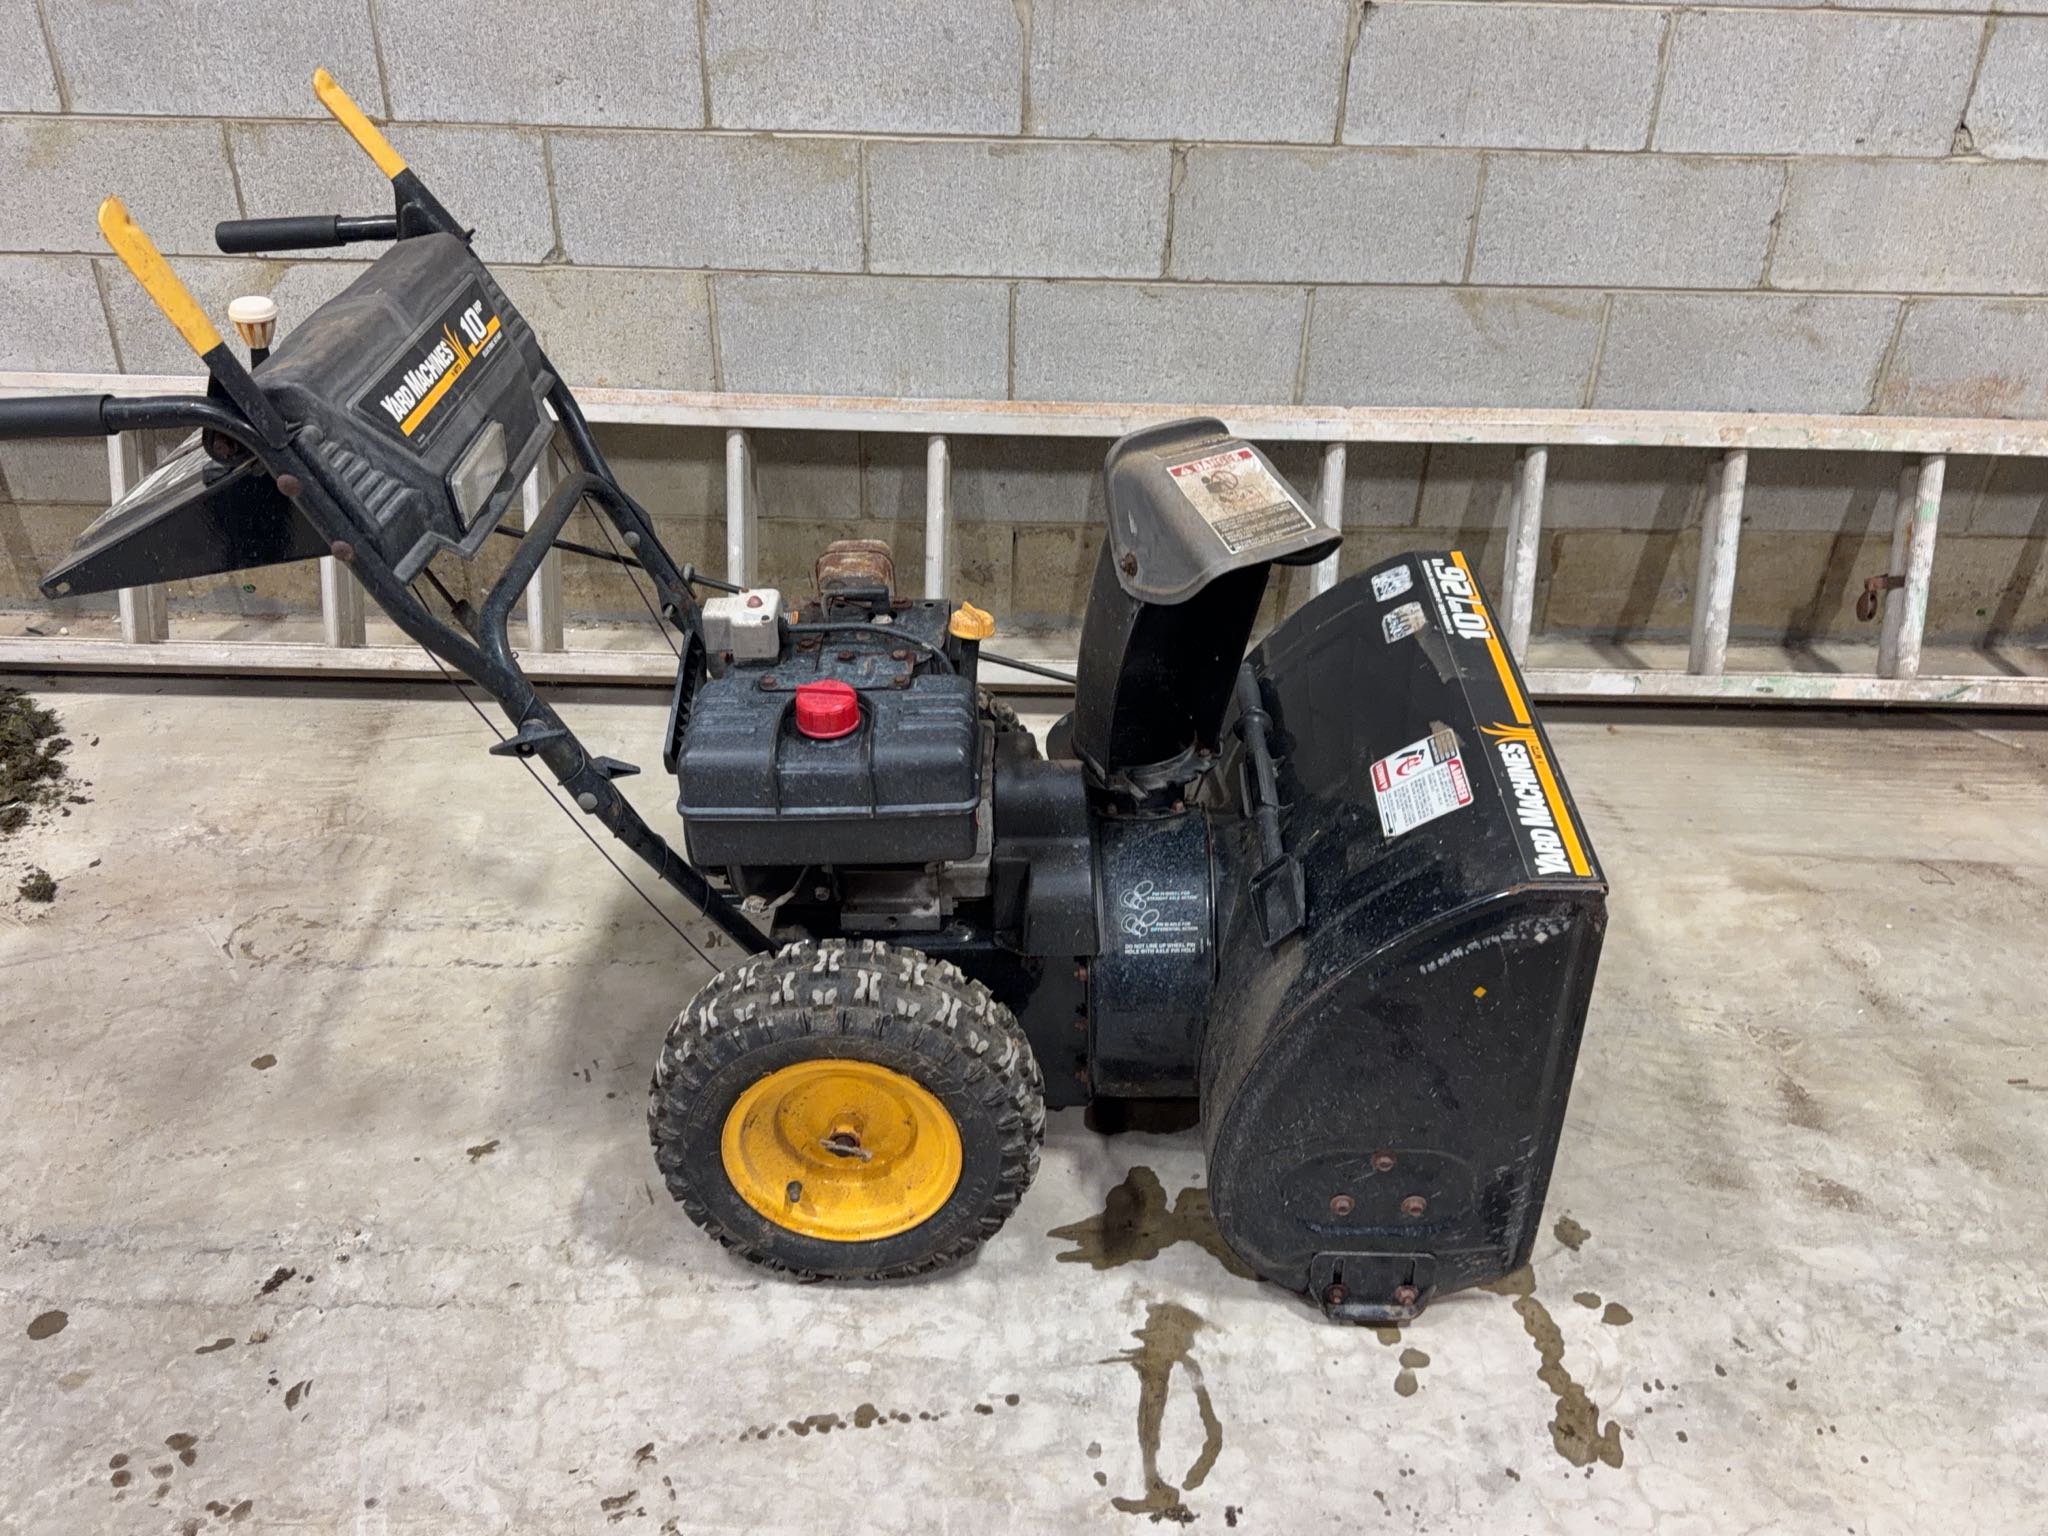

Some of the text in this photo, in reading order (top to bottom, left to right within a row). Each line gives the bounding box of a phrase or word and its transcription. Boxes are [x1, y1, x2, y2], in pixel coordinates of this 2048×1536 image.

[380, 340, 455, 423] YARD MACHINES
[1497, 743, 1571, 876] YARD MACHINES
